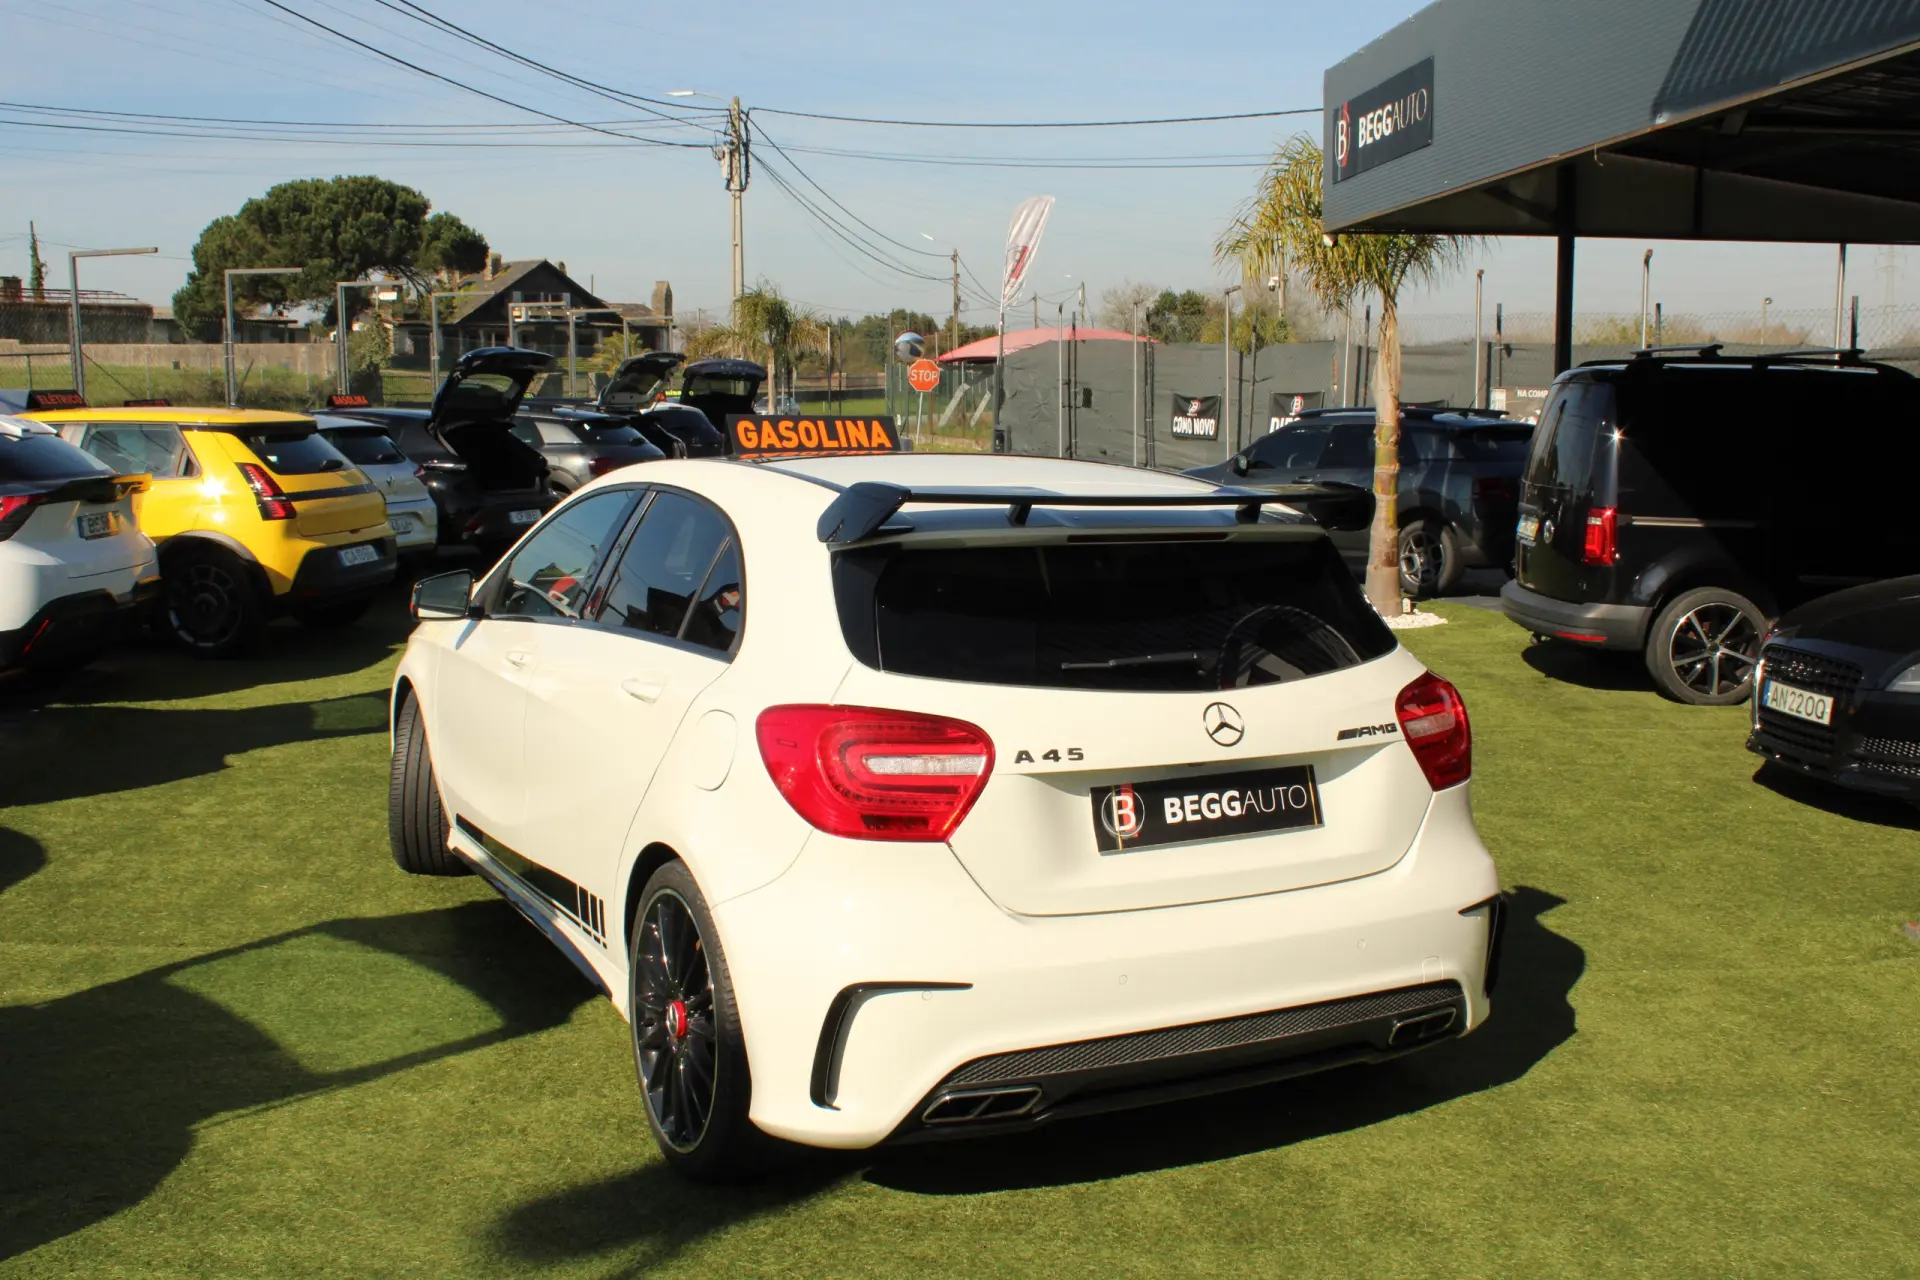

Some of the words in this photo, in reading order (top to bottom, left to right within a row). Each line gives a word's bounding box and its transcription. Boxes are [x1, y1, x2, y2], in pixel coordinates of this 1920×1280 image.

[1358, 88, 1428, 149] BEGGAUTO
[910, 369, 938, 382] STOP
[736, 420, 893, 449] GASOLINA
[1172, 415, 1193, 434] COMO
[1193, 417, 1215, 436] NOVO
[1358, 722, 1398, 738] AMG
[1163, 785, 1307, 824] BEGGAUTO
